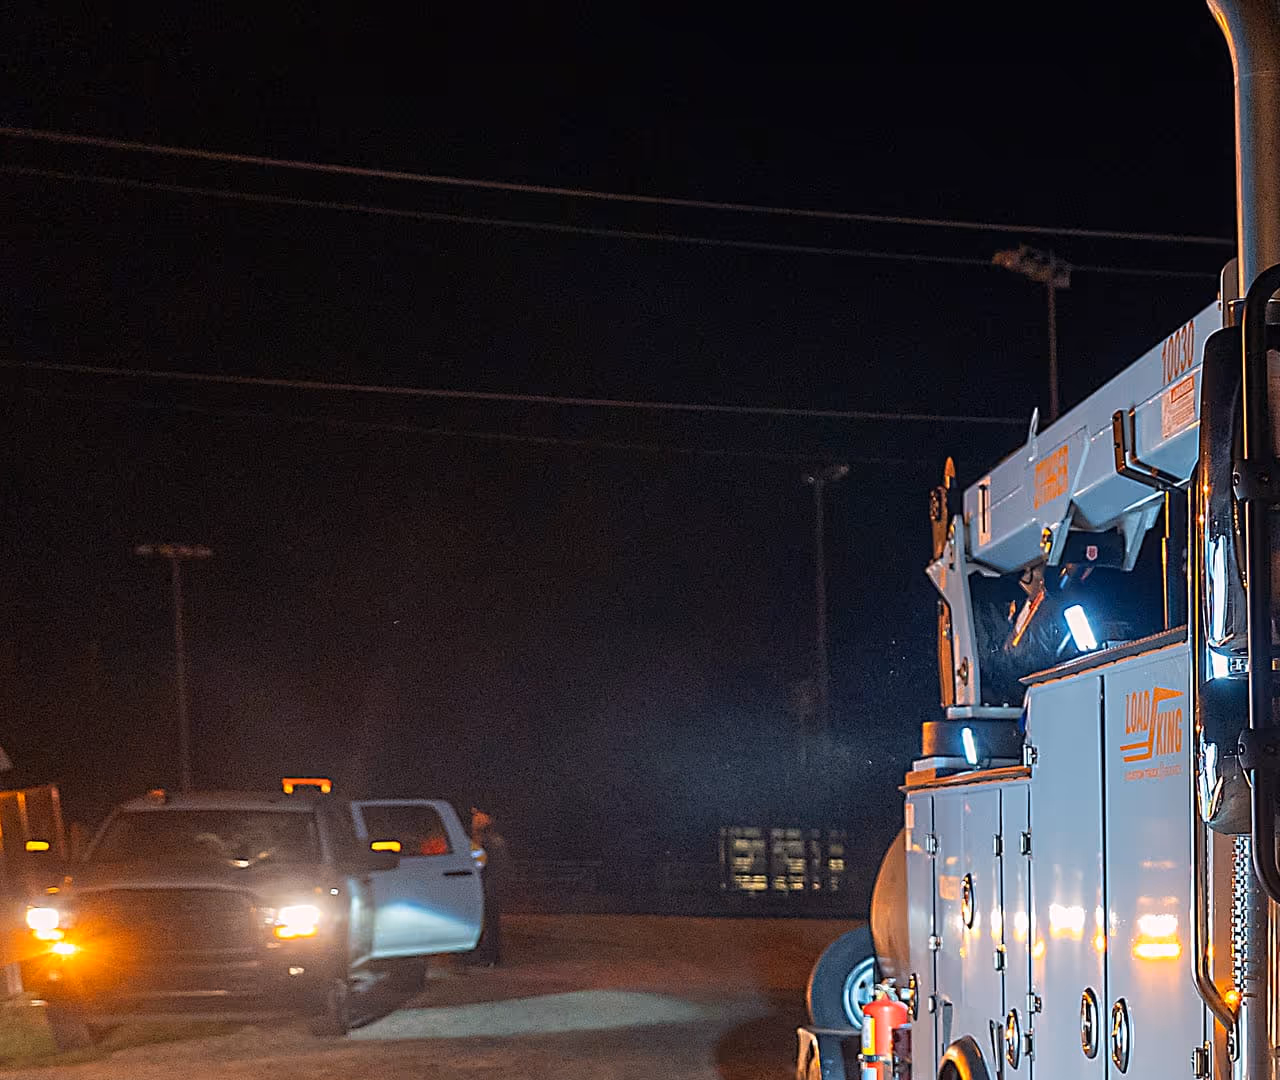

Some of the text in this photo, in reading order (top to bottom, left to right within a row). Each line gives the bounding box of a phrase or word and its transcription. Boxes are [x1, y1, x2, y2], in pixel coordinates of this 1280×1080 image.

[1162, 319, 1195, 386] 10030
[1126, 690, 1150, 735] LOAD
[1156, 708, 1183, 756] KING
